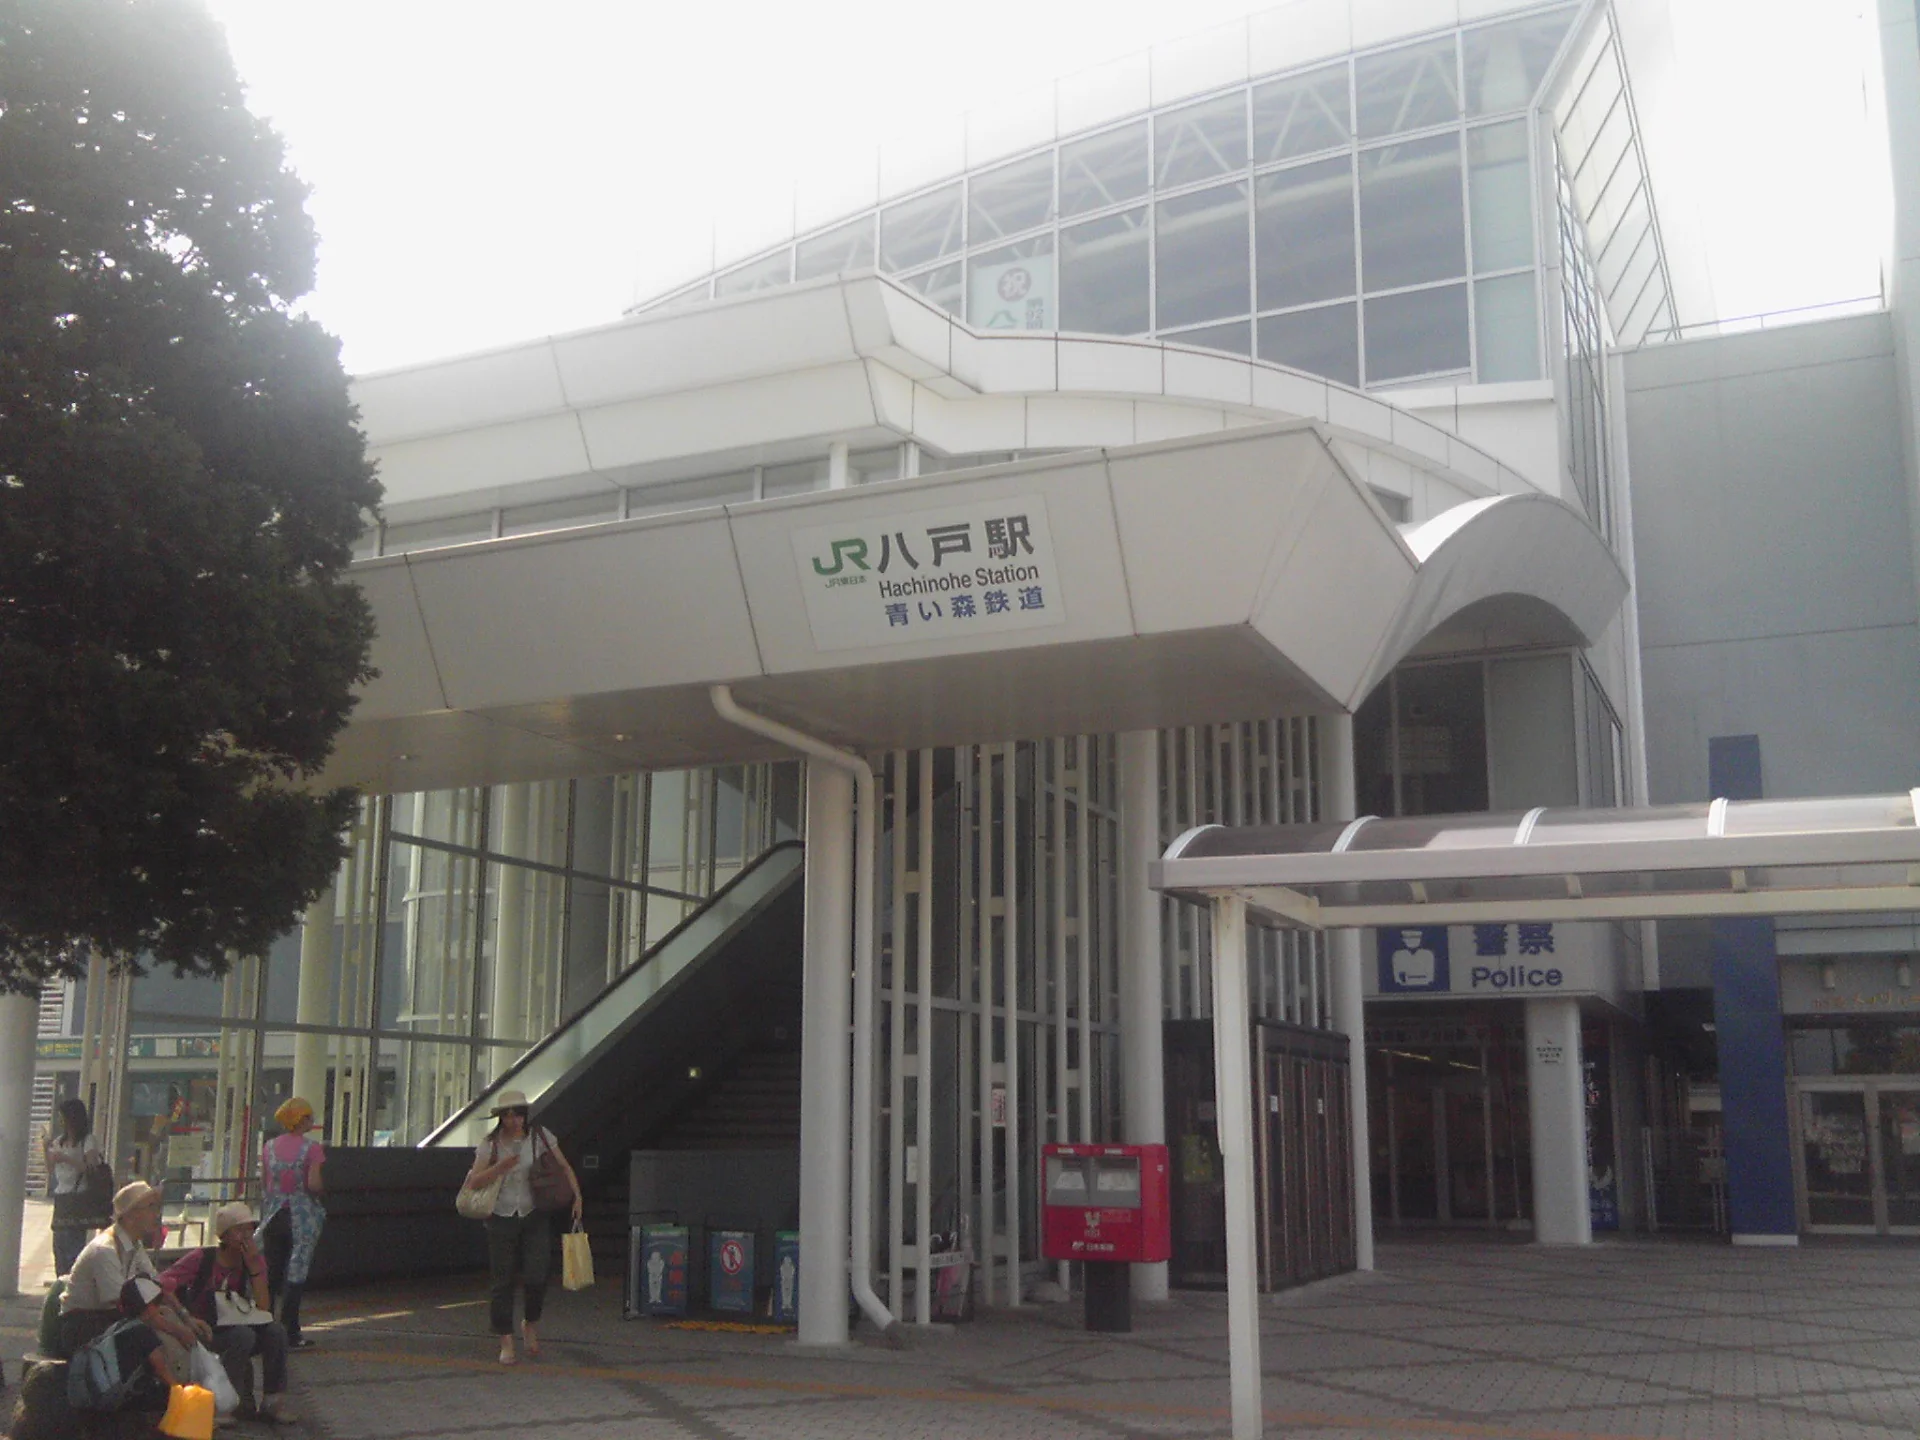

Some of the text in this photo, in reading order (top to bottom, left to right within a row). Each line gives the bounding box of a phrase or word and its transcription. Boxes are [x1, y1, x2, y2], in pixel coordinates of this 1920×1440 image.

[811, 537, 872, 576] JR
[877, 514, 1035, 574] 八戸駅
[878, 562, 1040, 599] Hachinohe Station
[884, 585, 1046, 627] 青い森鉄道
[1471, 964, 1564, 989] Police
